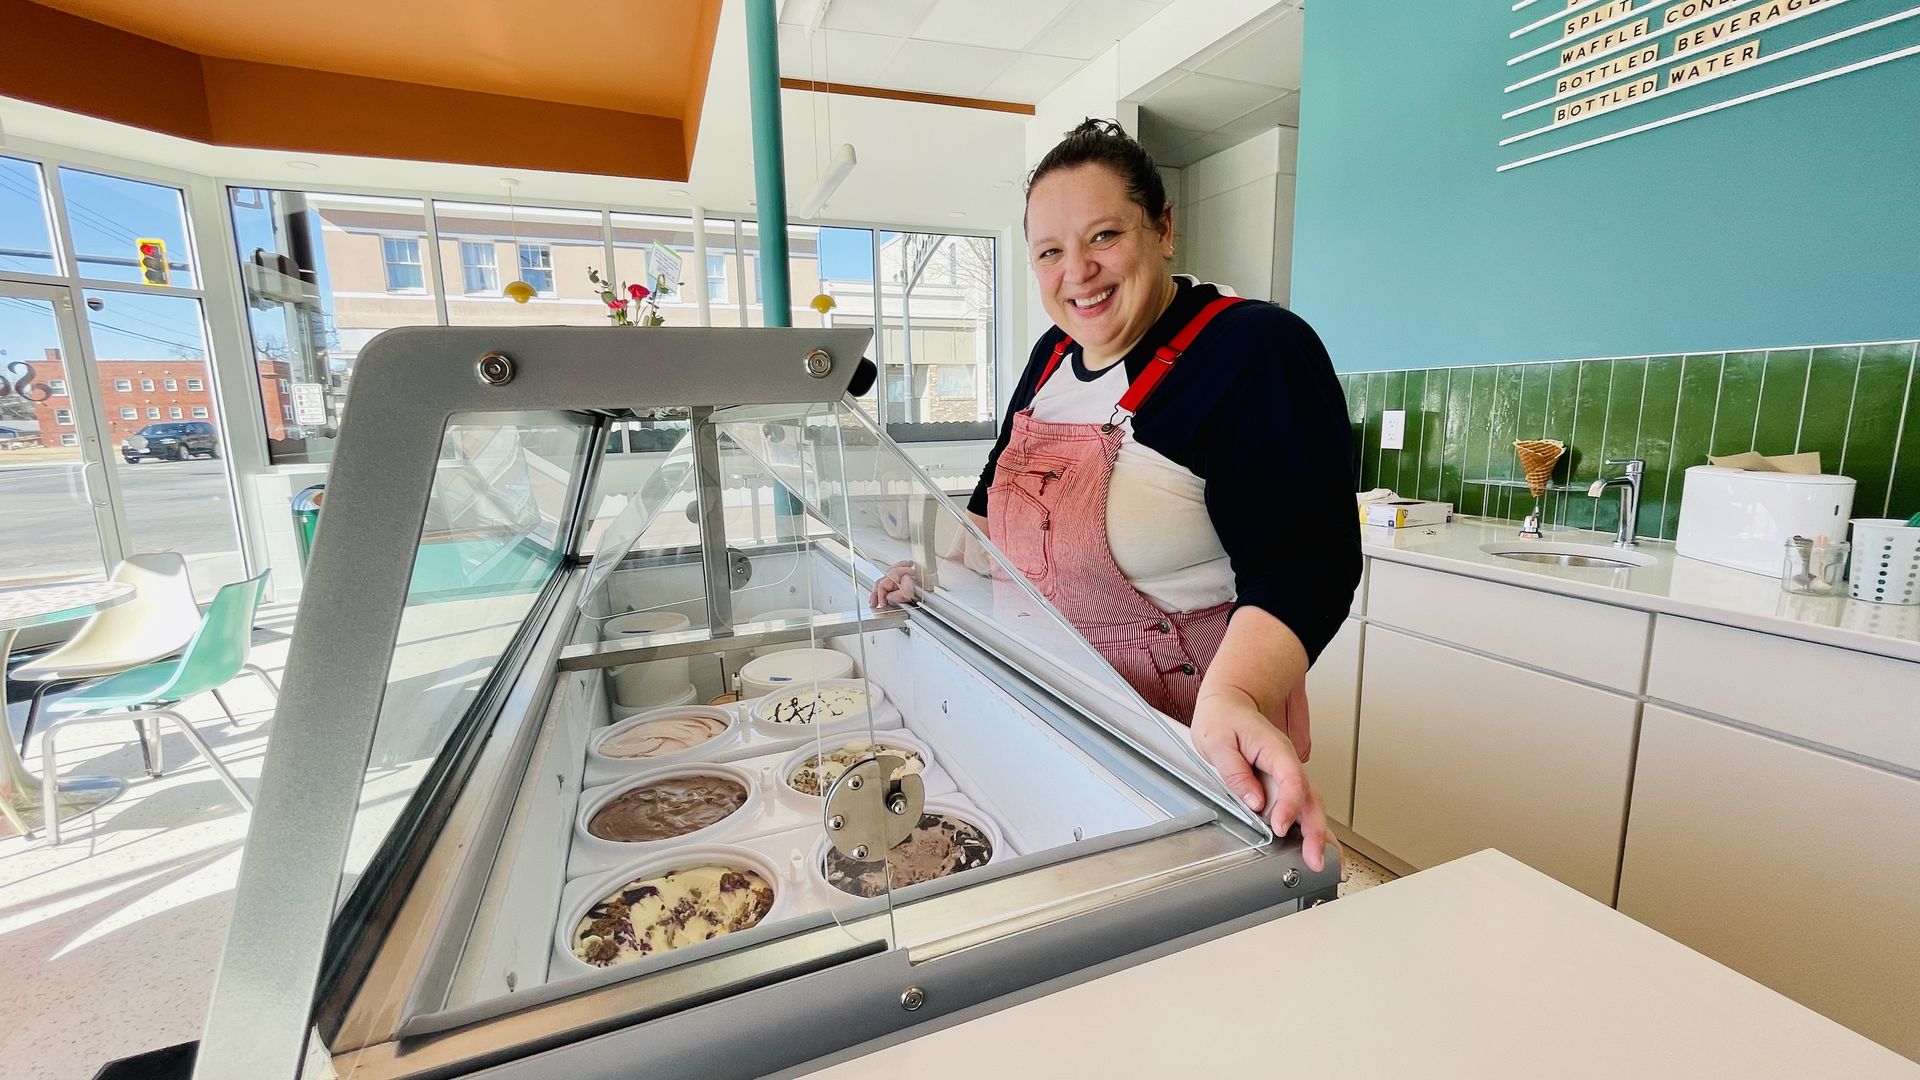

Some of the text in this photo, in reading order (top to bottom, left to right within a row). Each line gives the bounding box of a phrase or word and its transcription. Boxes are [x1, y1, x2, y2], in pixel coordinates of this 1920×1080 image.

[1567, 0, 1629, 34] SPLIT
[1562, 23, 1643, 64] WAFFLE
[1557, 46, 1754, 121] BOTTLED WATER
[1559, 50, 1655, 93] BOTTLED
